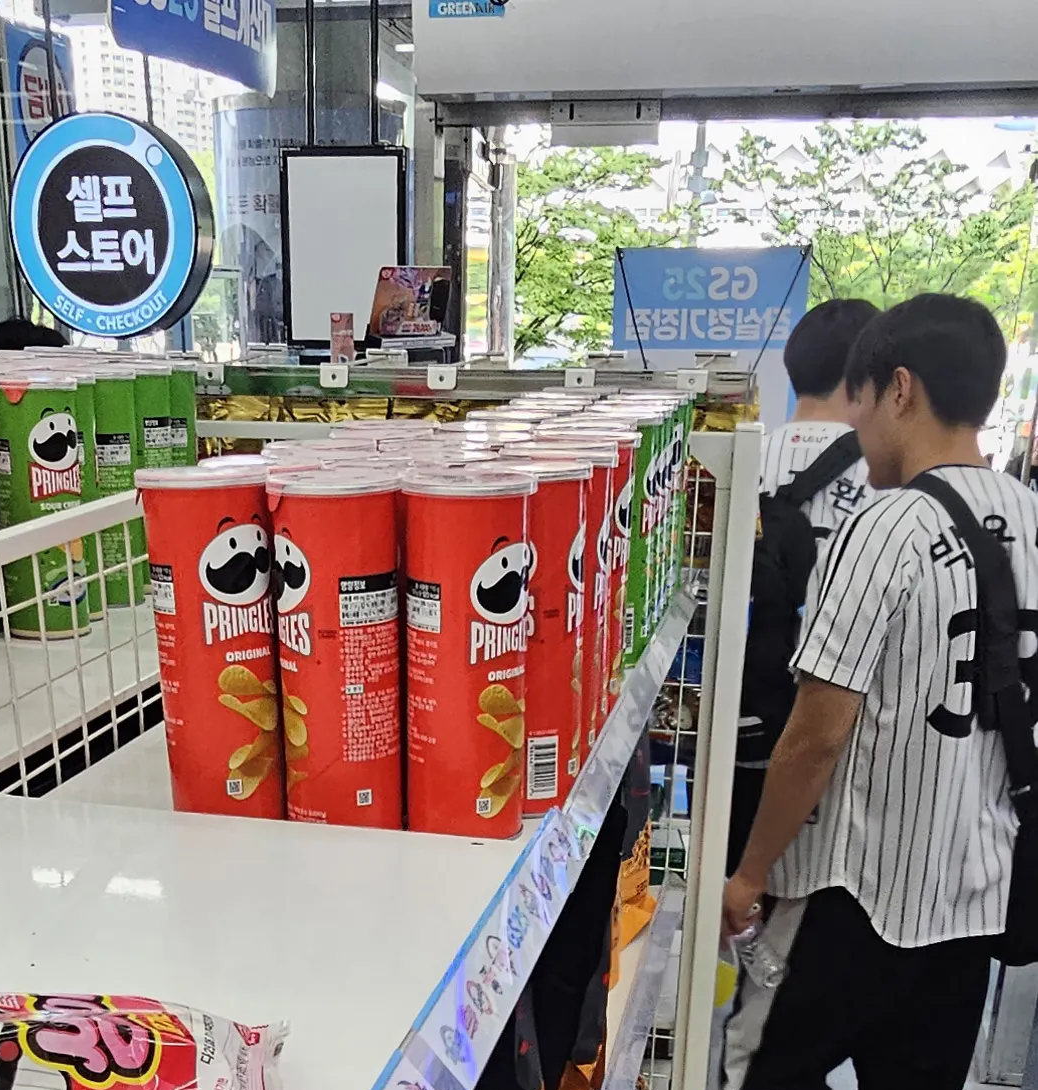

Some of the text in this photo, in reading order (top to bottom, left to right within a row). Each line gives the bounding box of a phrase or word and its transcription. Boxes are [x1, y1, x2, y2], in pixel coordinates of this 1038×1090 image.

[66, 175, 137, 222] 셀프
[57, 229, 156, 275] 스토어
[53, 294, 85, 322] SELF
[95, 291, 168, 331] CHECKOUT
[225, 646, 271, 662] ORIGINAL
